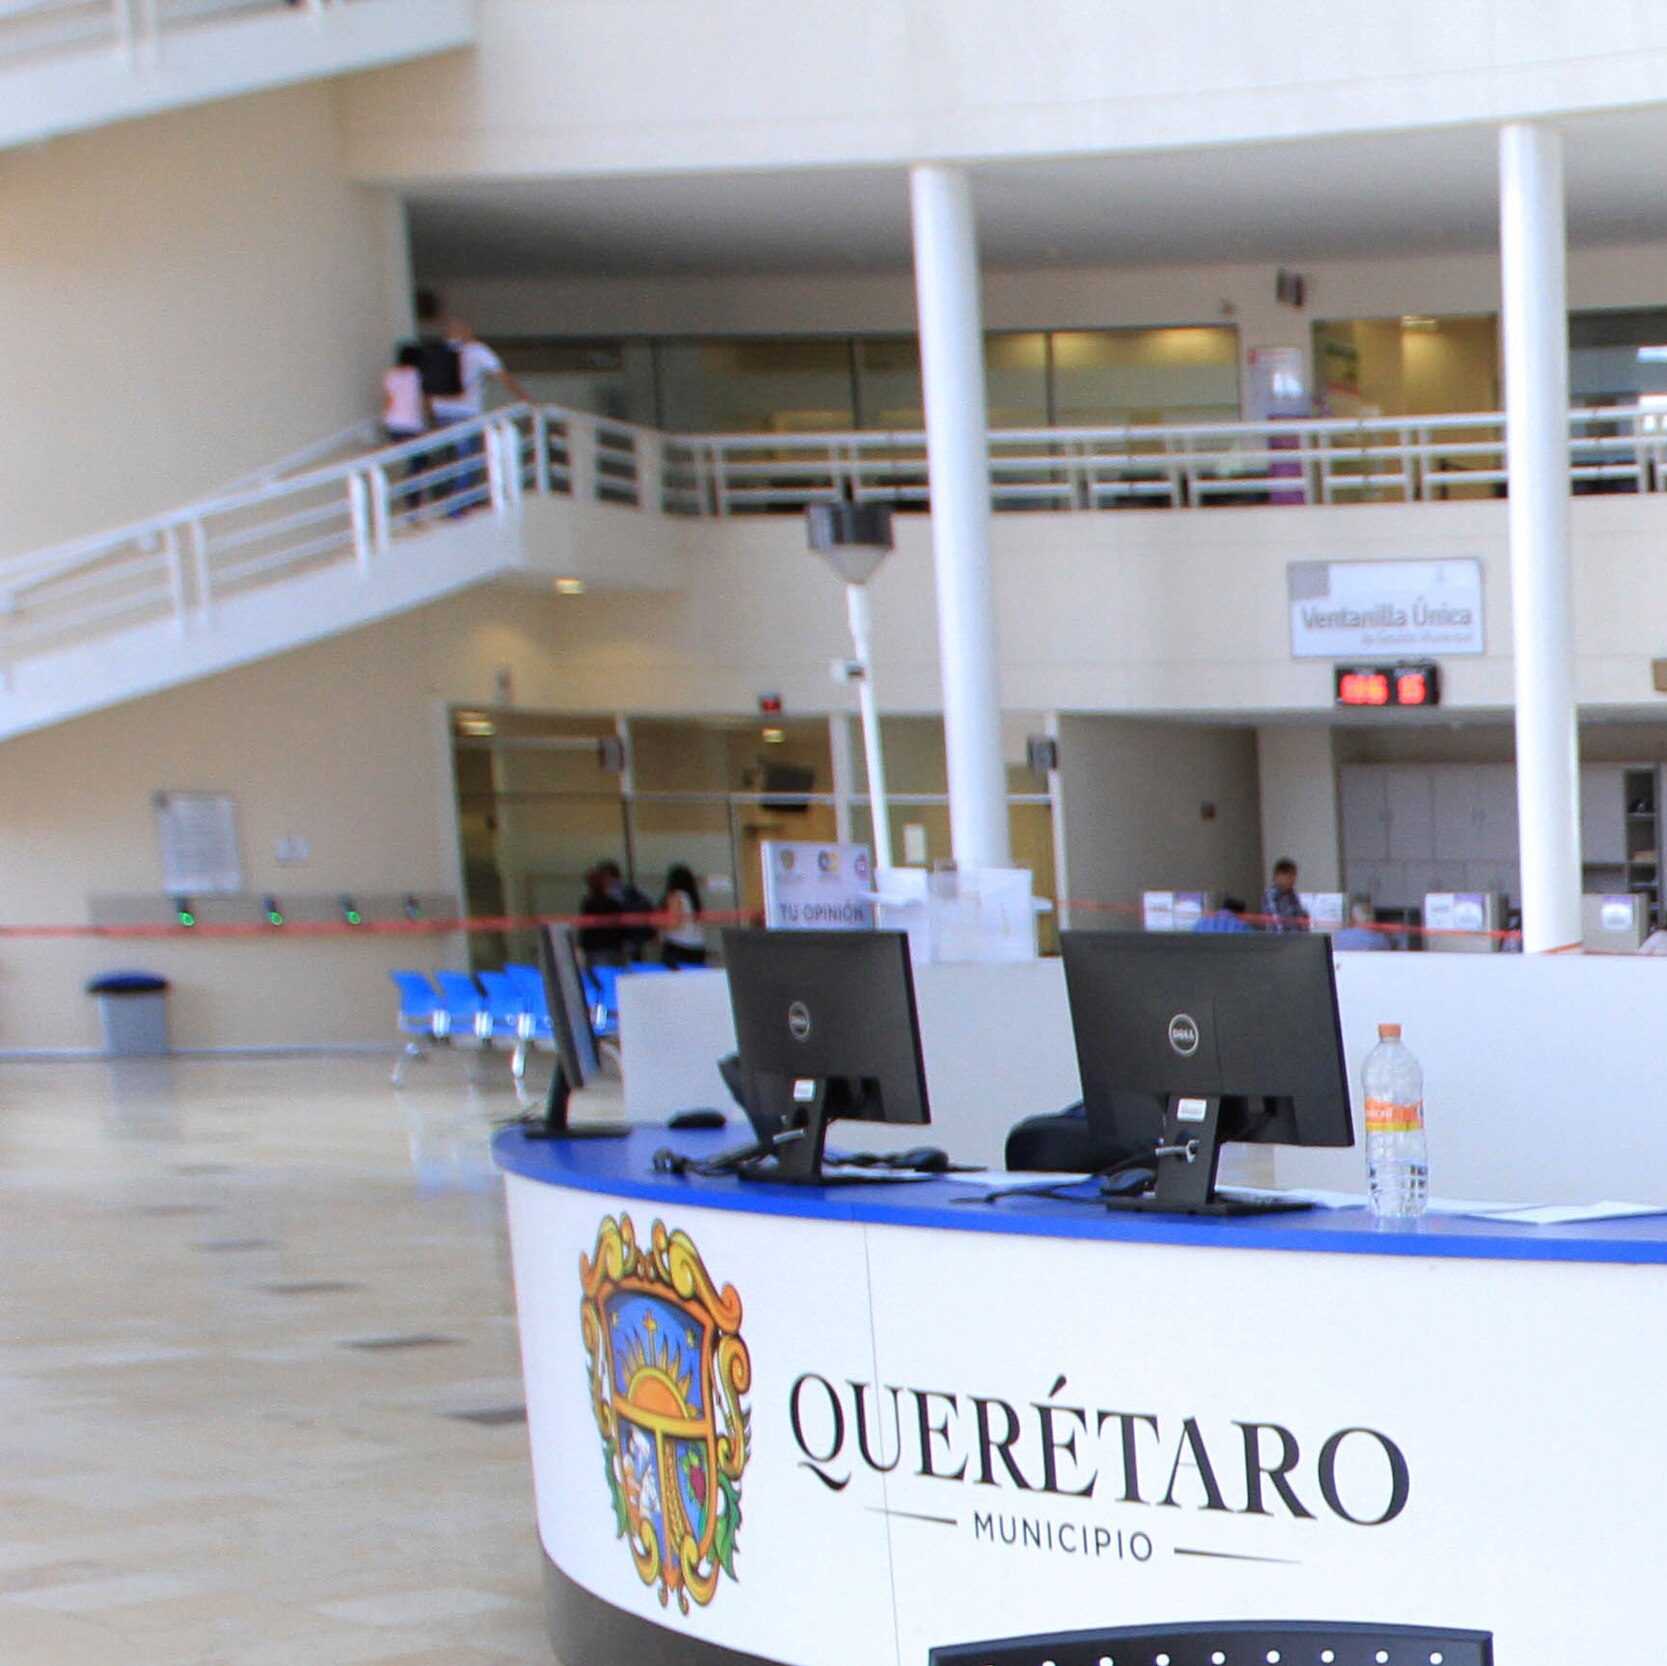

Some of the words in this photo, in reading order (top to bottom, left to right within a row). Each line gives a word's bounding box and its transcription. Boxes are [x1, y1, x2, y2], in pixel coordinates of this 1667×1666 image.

[1302, 603, 1408, 630] Ventanilla
[1412, 595, 1473, 626] Única
[789, 1374, 1411, 1527] QUERÉTARO
[973, 1511, 1154, 1564] MUNICIPIO
